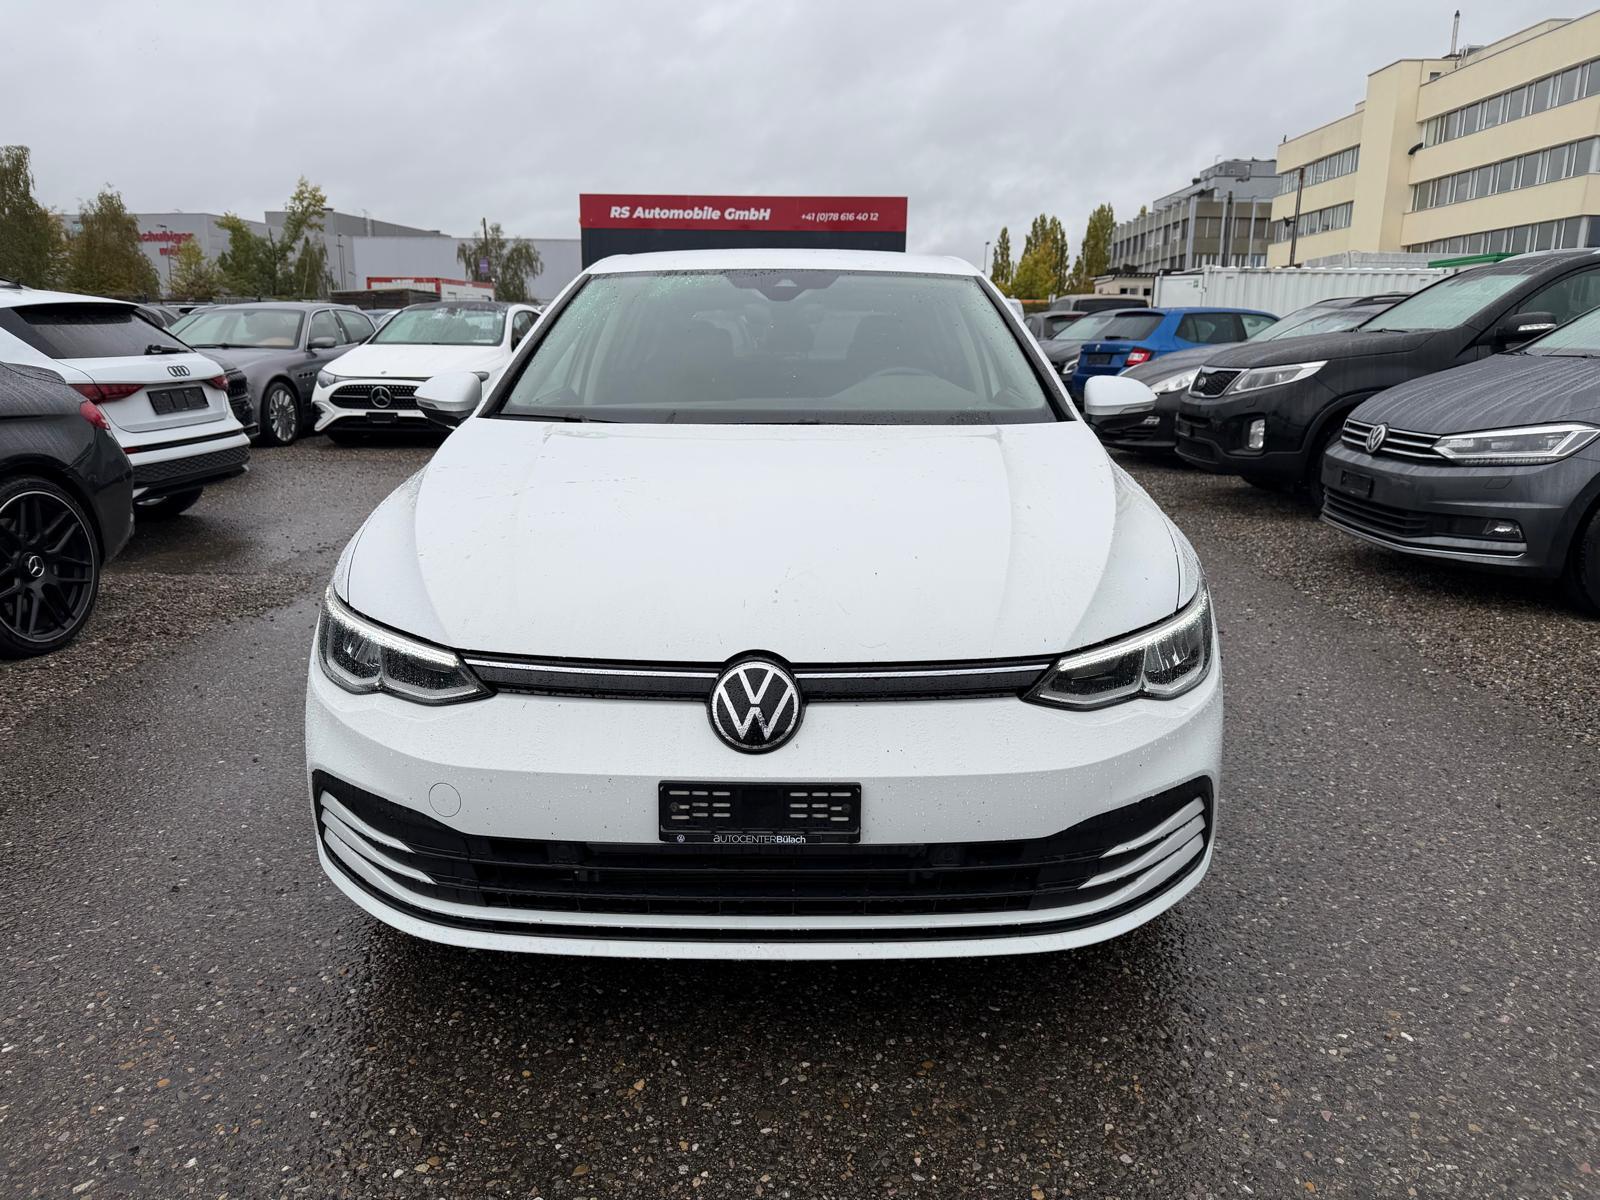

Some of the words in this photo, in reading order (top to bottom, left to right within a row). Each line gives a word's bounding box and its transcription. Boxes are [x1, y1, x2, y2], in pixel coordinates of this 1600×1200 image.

[610, 206, 630, 218] RS
[633, 206, 721, 219] Automobile
[724, 208, 771, 220] GmbH
[801, 212, 815, 220] +41
[816, 212, 839, 222] (0)78
[840, 212, 855, 221] 616
[856, 213, 868, 221] 40
[869, 213, 879, 221] 12
[714, 662, 797, 746] VW
